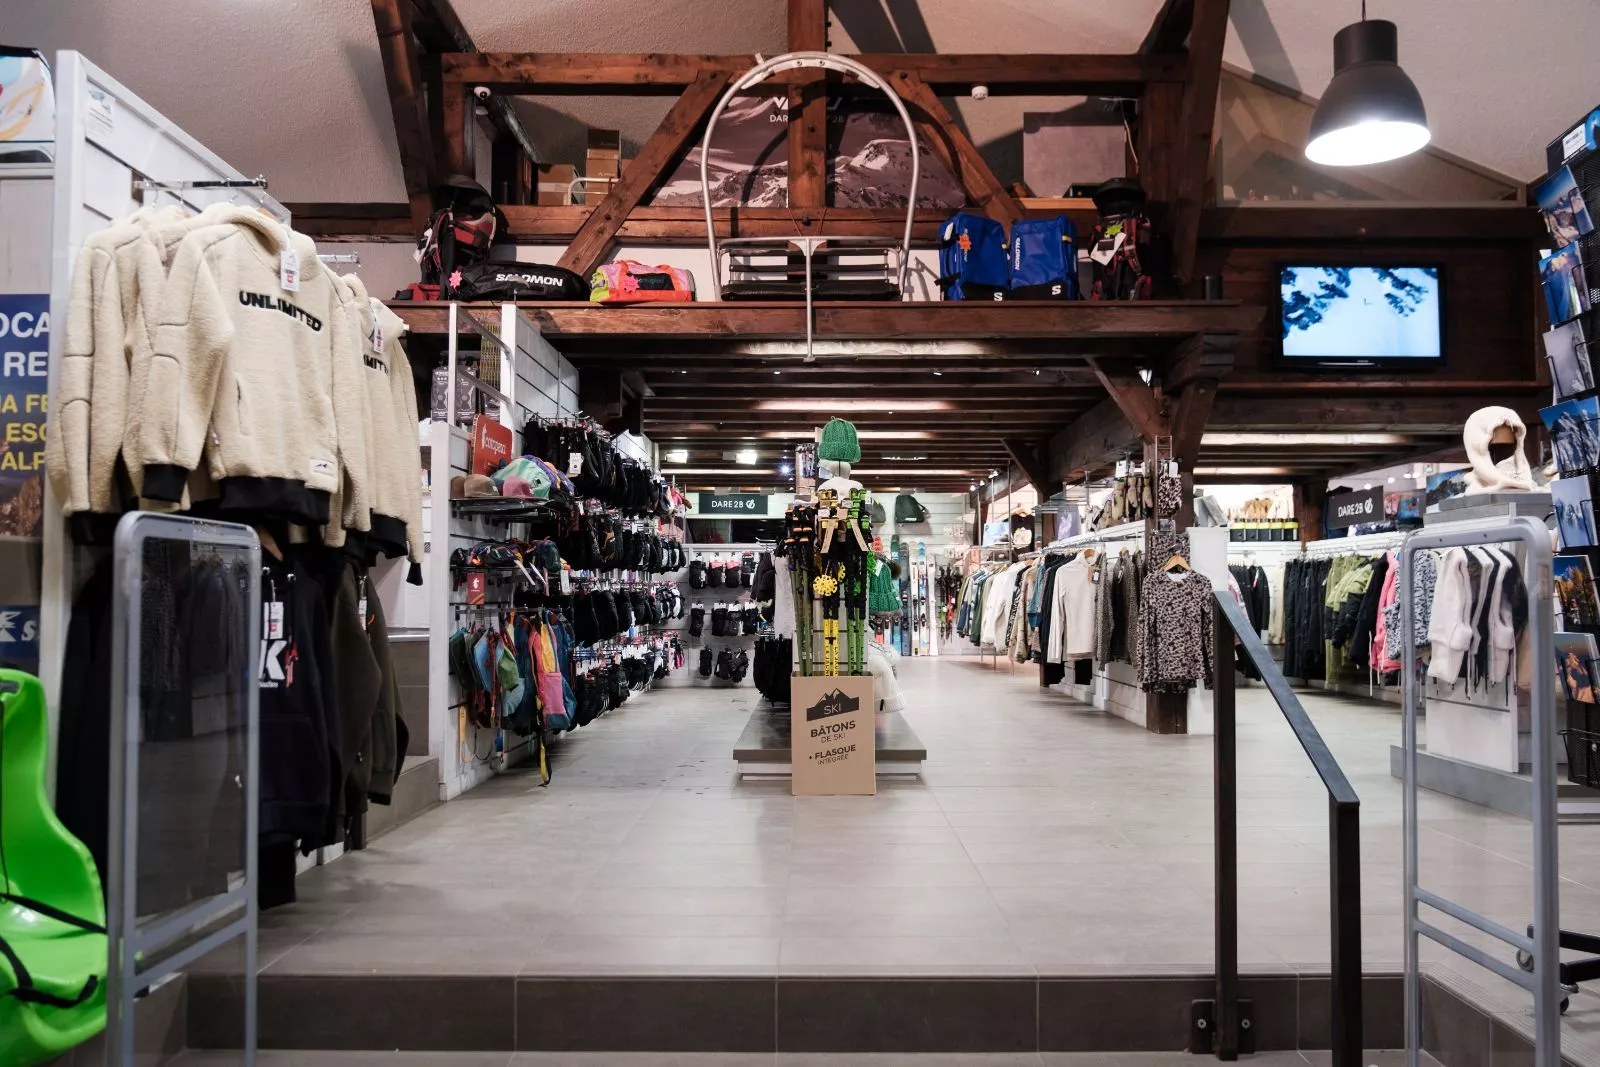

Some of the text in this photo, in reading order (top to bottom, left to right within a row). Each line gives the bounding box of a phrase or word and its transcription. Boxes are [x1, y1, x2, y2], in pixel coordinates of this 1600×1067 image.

[769, 114, 789, 123] DAR
[495, 273, 564, 287] SAOMON
[239, 290, 323, 332] UNLIMITED
[711, 500, 744, 508] DARE 2B
[1338, 503, 1355, 518] DARE
[824, 702, 842, 715] SKI
[821, 733, 846, 744] DE SKI
[815, 744, 857, 760] FLASQUE
